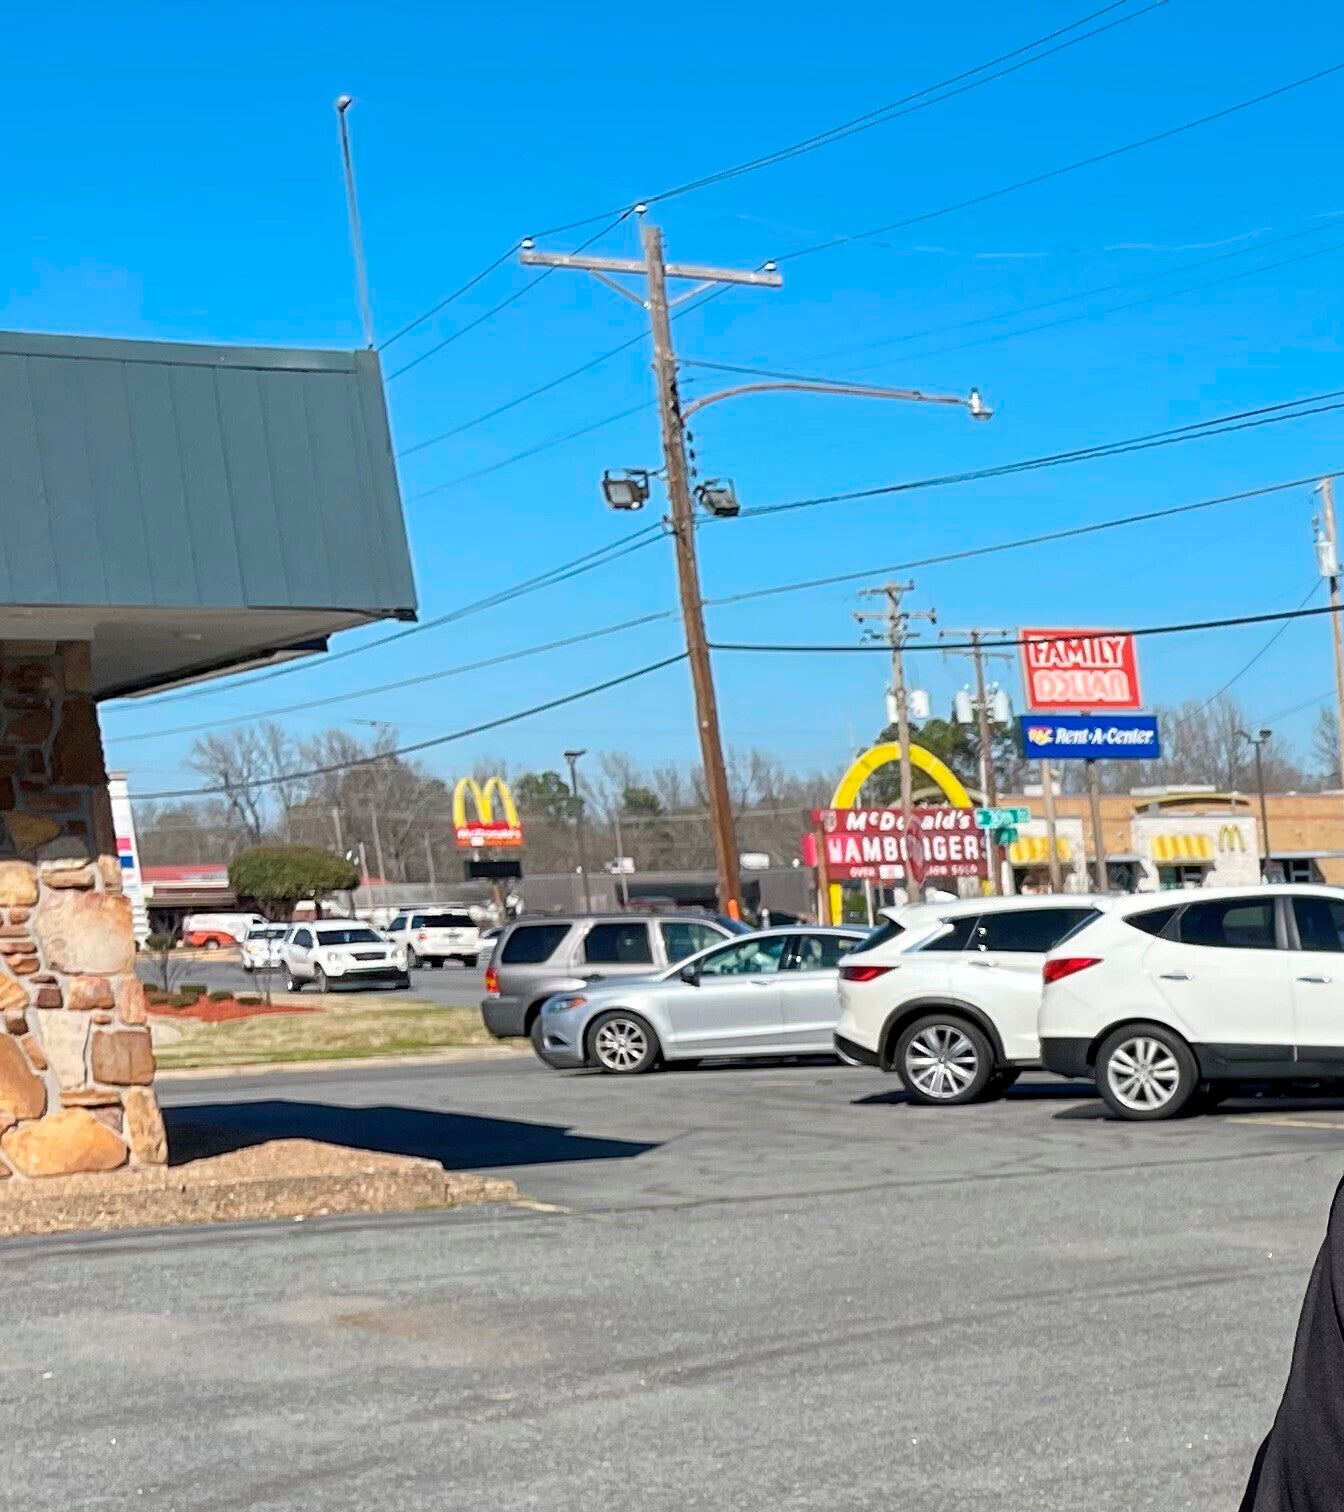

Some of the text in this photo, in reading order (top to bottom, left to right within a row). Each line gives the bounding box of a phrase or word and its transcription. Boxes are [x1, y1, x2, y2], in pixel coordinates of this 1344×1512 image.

[1028, 634, 1127, 668] FAMILY
[846, 810, 971, 831] McDoald's
[828, 833, 987, 864] HAMBGER
